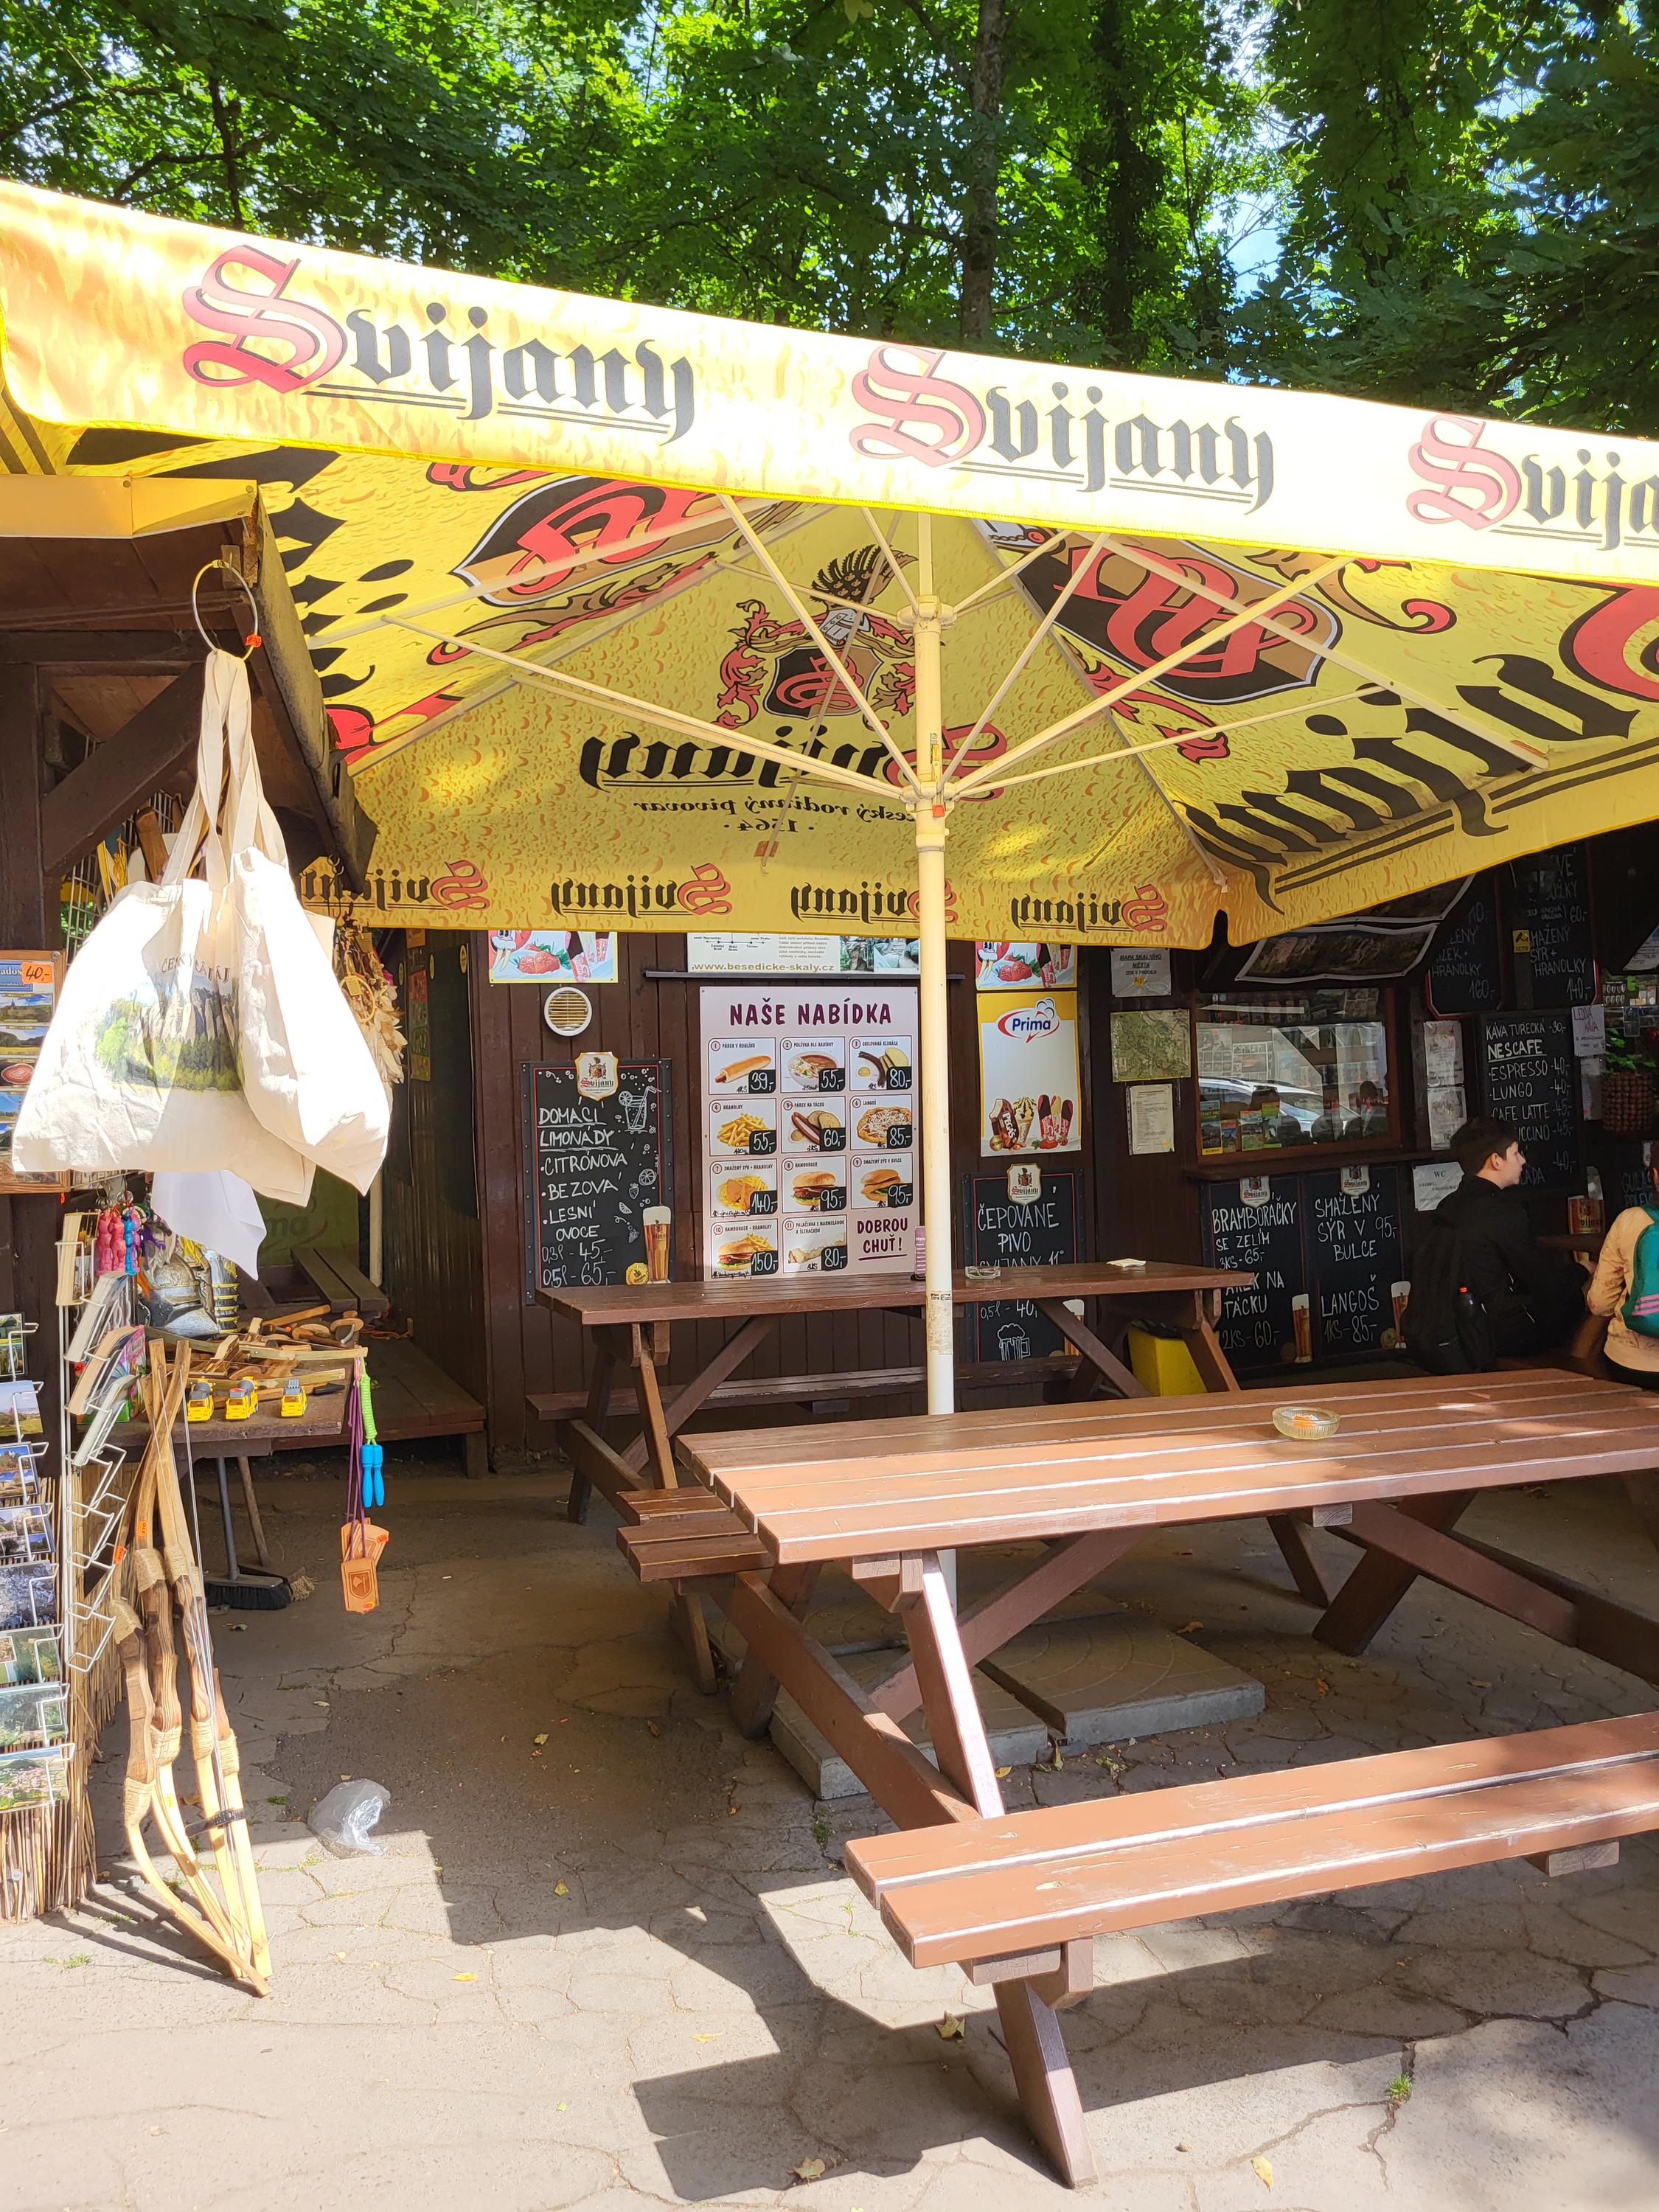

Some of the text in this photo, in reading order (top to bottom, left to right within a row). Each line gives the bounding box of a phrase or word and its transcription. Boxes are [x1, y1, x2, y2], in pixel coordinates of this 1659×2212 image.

[182, 244, 695, 445] Svijany
[849, 344, 1273, 515] Svijany
[694, 962, 835, 973] www.besedicke-skaly.cz
[1534, 958, 1587, 977] HRANOLKY
[730, 997, 891, 1026] NAŠE NABÍDKA
[1012, 1017, 1051, 1032] Prima
[1486, 1022, 1508, 1040] KÁVA
[1487, 1039, 1543, 1060] NESCAFE
[821, 1071, 844, 1090] 55,-
[889, 1068, 911, 1089] 80,-
[1492, 1059, 1548, 1082] ESPRESSO
[580, 1077, 614, 1088] Svijany
[751, 1072, 774, 1090] 39,-
[1492, 1082, 1533, 1101] LUNGO
[1522, 1102, 1550, 1120] LATTE
[540, 1126, 615, 1147] LIMONÁDY
[753, 1132, 775, 1151] 55,-
[823, 1130, 846, 1147] 60,-
[890, 1126, 911, 1146] 85,-
[548, 1172, 622, 1200] BEZOVÁ
[888, 1185, 911, 1204] 95,-
[821, 1189, 845, 1208] 95,-
[549, 1200, 597, 1224] LESNÍ
[1212, 1192, 1297, 1234] BRAMBORÁČKY
[556, 1225, 600, 1241] OVOCE
[857, 1217, 908, 1234] DOBROU
[1318, 1214, 1398, 1242] SÝR V 95,-
[998, 1231, 1031, 1253] PIVO
[1216, 1228, 1270, 1251] SE ZELÍM
[824, 1248, 847, 1268] 80,-
[1333, 1239, 1377, 1262] BULCE
[1267, 1270, 1285, 1290] NA
[1321, 1274, 1380, 1317] LANGOŠ
[1224, 1294, 1267, 1319] TÁCKU
